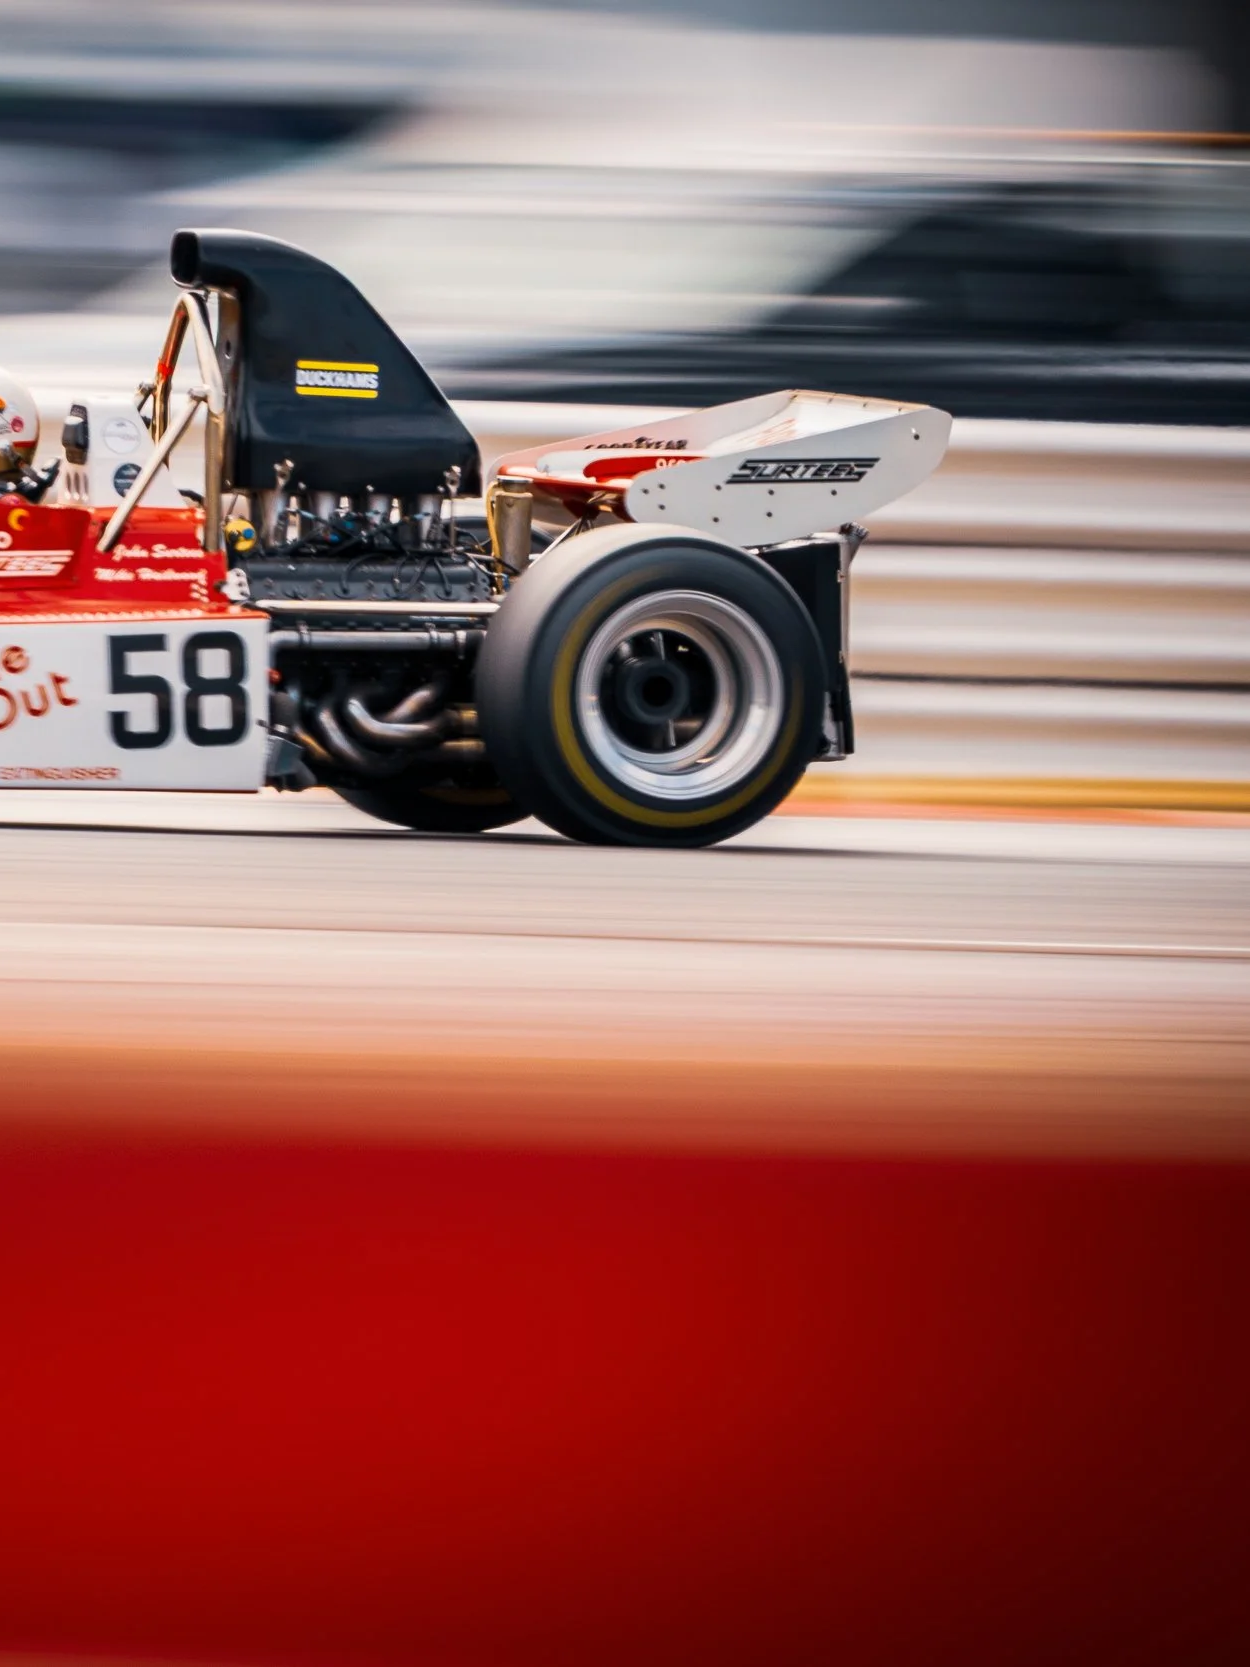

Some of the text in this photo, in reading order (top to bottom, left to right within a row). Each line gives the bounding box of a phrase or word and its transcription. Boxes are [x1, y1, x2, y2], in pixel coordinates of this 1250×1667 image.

[296, 369, 379, 389] DUCKHAMS
[726, 457, 881, 484] SURTEES
[107, 631, 251, 750] 58
